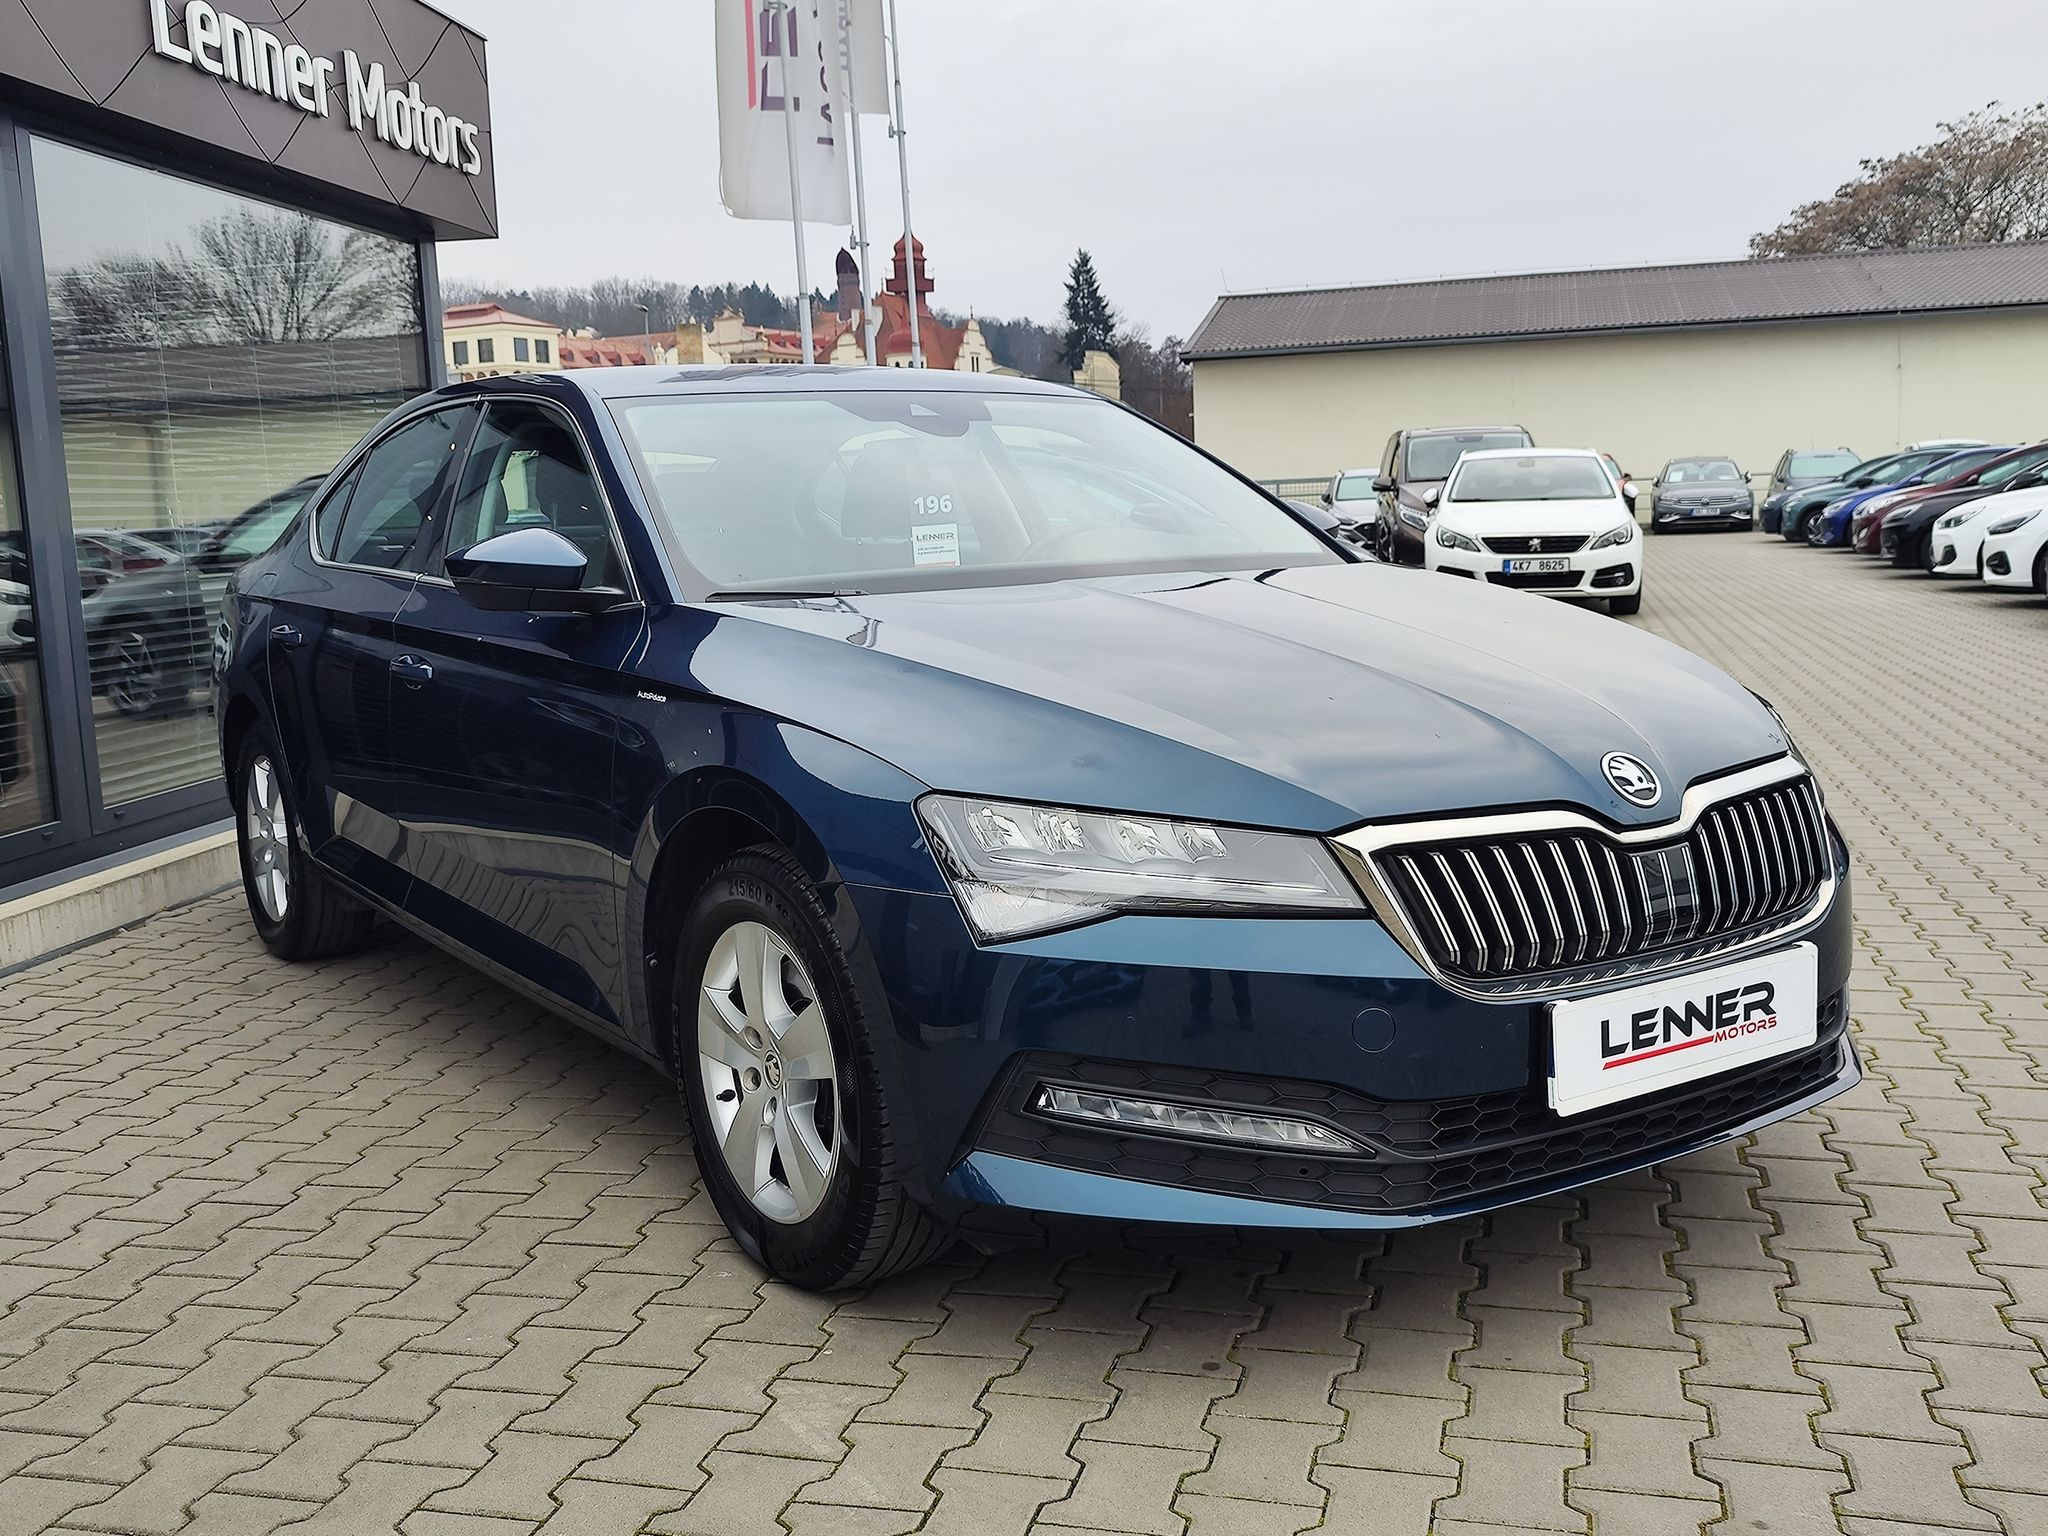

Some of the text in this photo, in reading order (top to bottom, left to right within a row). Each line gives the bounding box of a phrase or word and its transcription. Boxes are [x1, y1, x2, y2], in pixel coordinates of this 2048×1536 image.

[150, 0, 482, 176] Lenner Motors
[914, 494, 953, 515] 196
[916, 532, 955, 542] LENNER
[1512, 560, 1531, 572] 4K7
[1538, 560, 1565, 571] 8625
[1600, 981, 1777, 1059] LENNER
[1714, 1015, 1777, 1043] MOTORS
